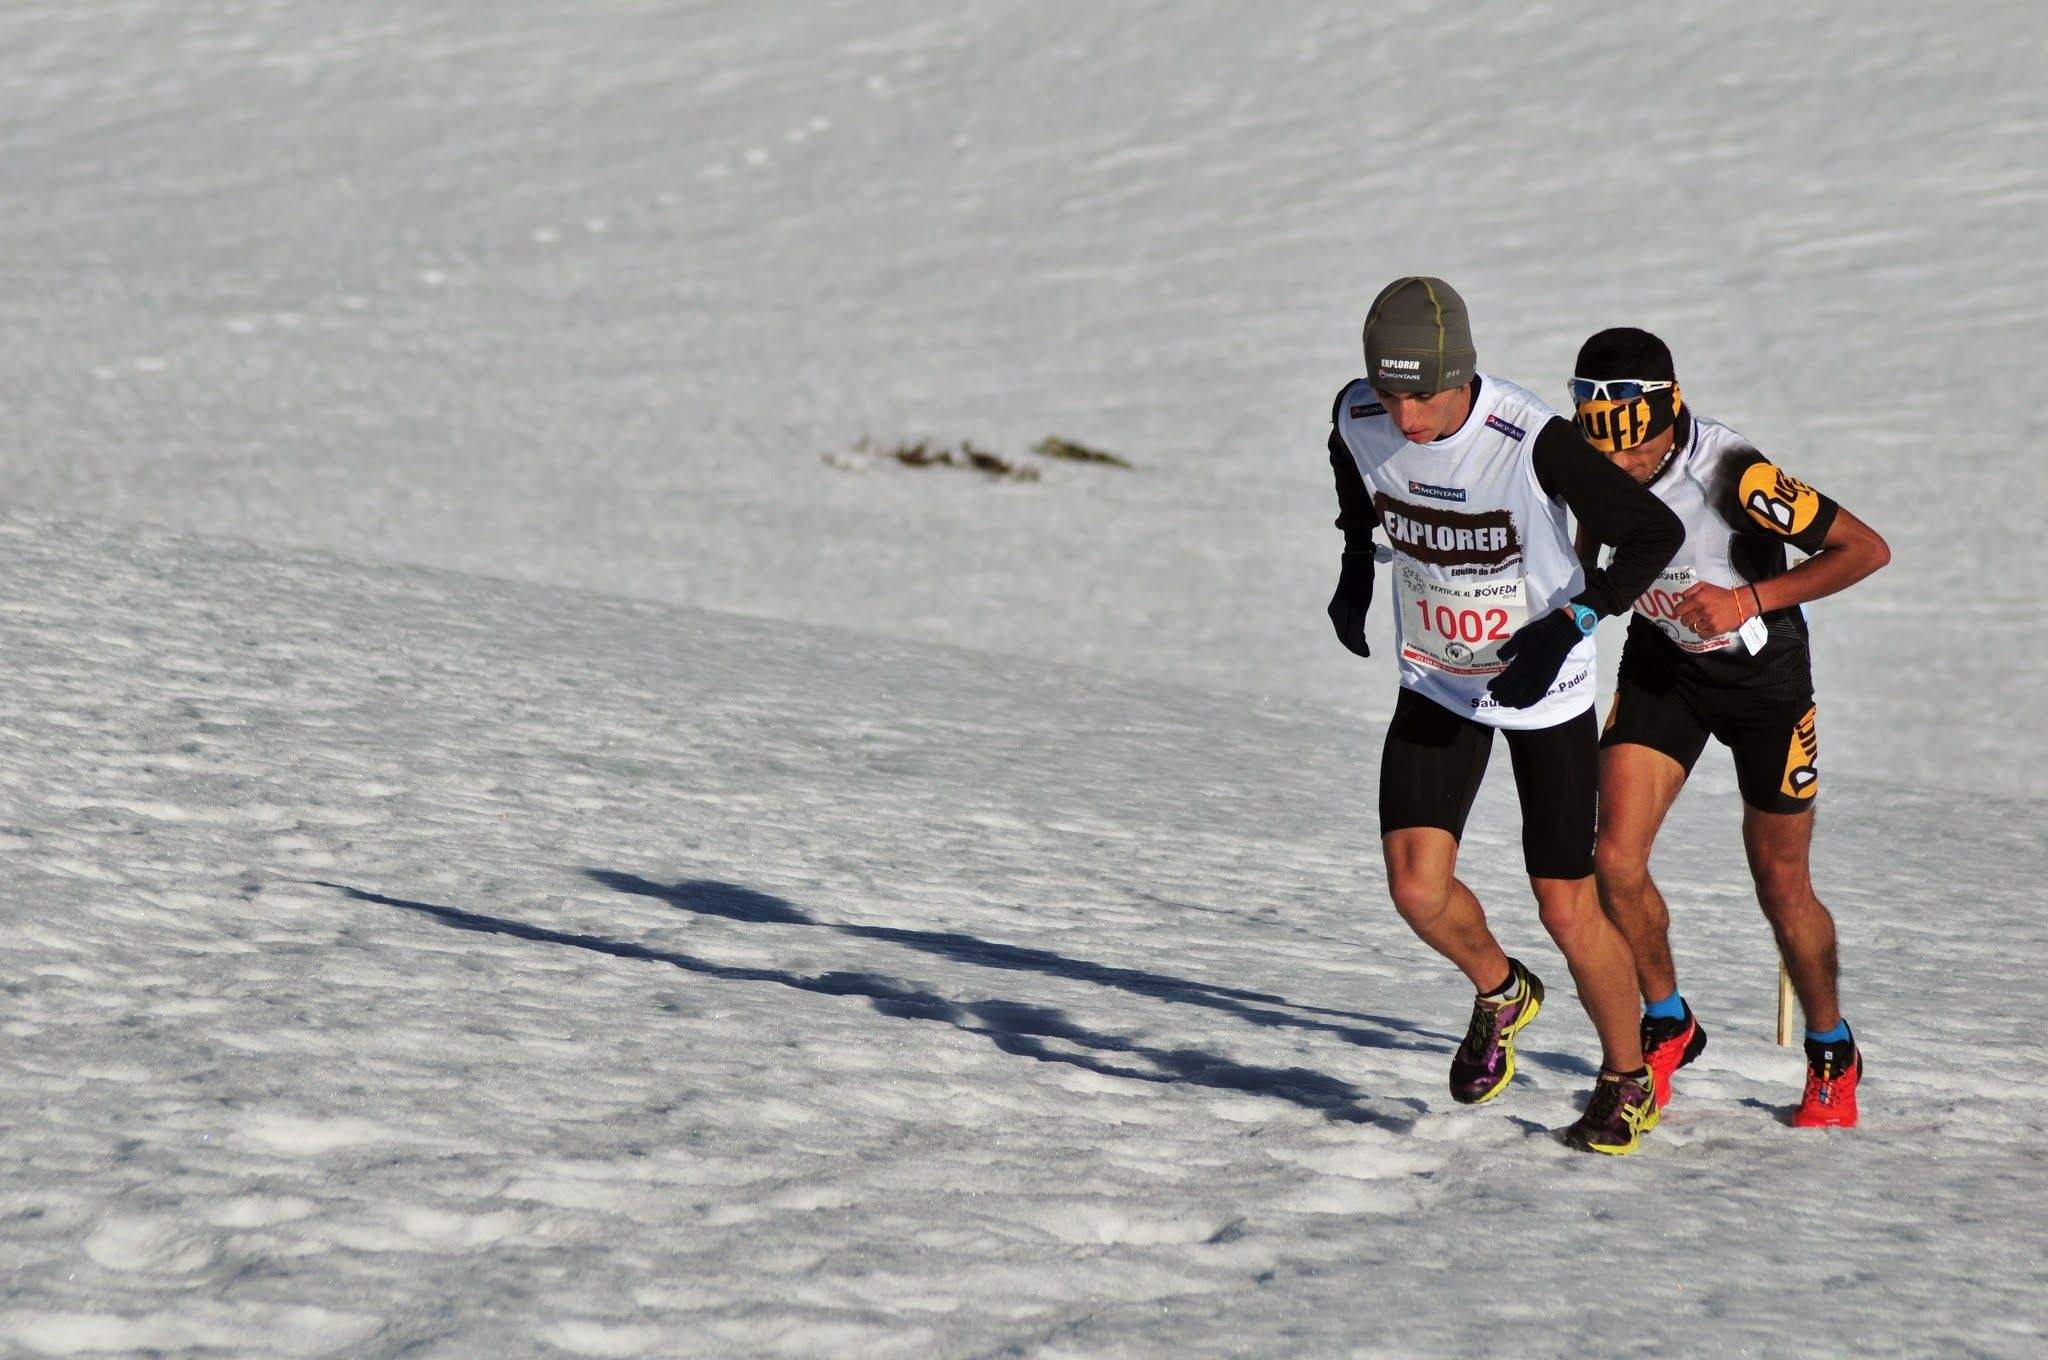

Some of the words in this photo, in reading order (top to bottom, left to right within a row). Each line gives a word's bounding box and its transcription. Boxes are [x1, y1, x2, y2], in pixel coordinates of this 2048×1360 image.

[1381, 359, 1420, 370] EXPLORER
[1386, 372, 1421, 381] MONTANE
[1420, 487, 1465, 500] MONTANE
[1384, 510, 1508, 552] EXPLORER
[1478, 566, 1489, 576] de
[1429, 583, 1462, 597] VERTICAL
[1463, 590, 1472, 598] AL
[1473, 583, 1518, 598] BÓVEDA
[1416, 598, 1511, 644] 1002
[1558, 669, 1589, 693] Padua
